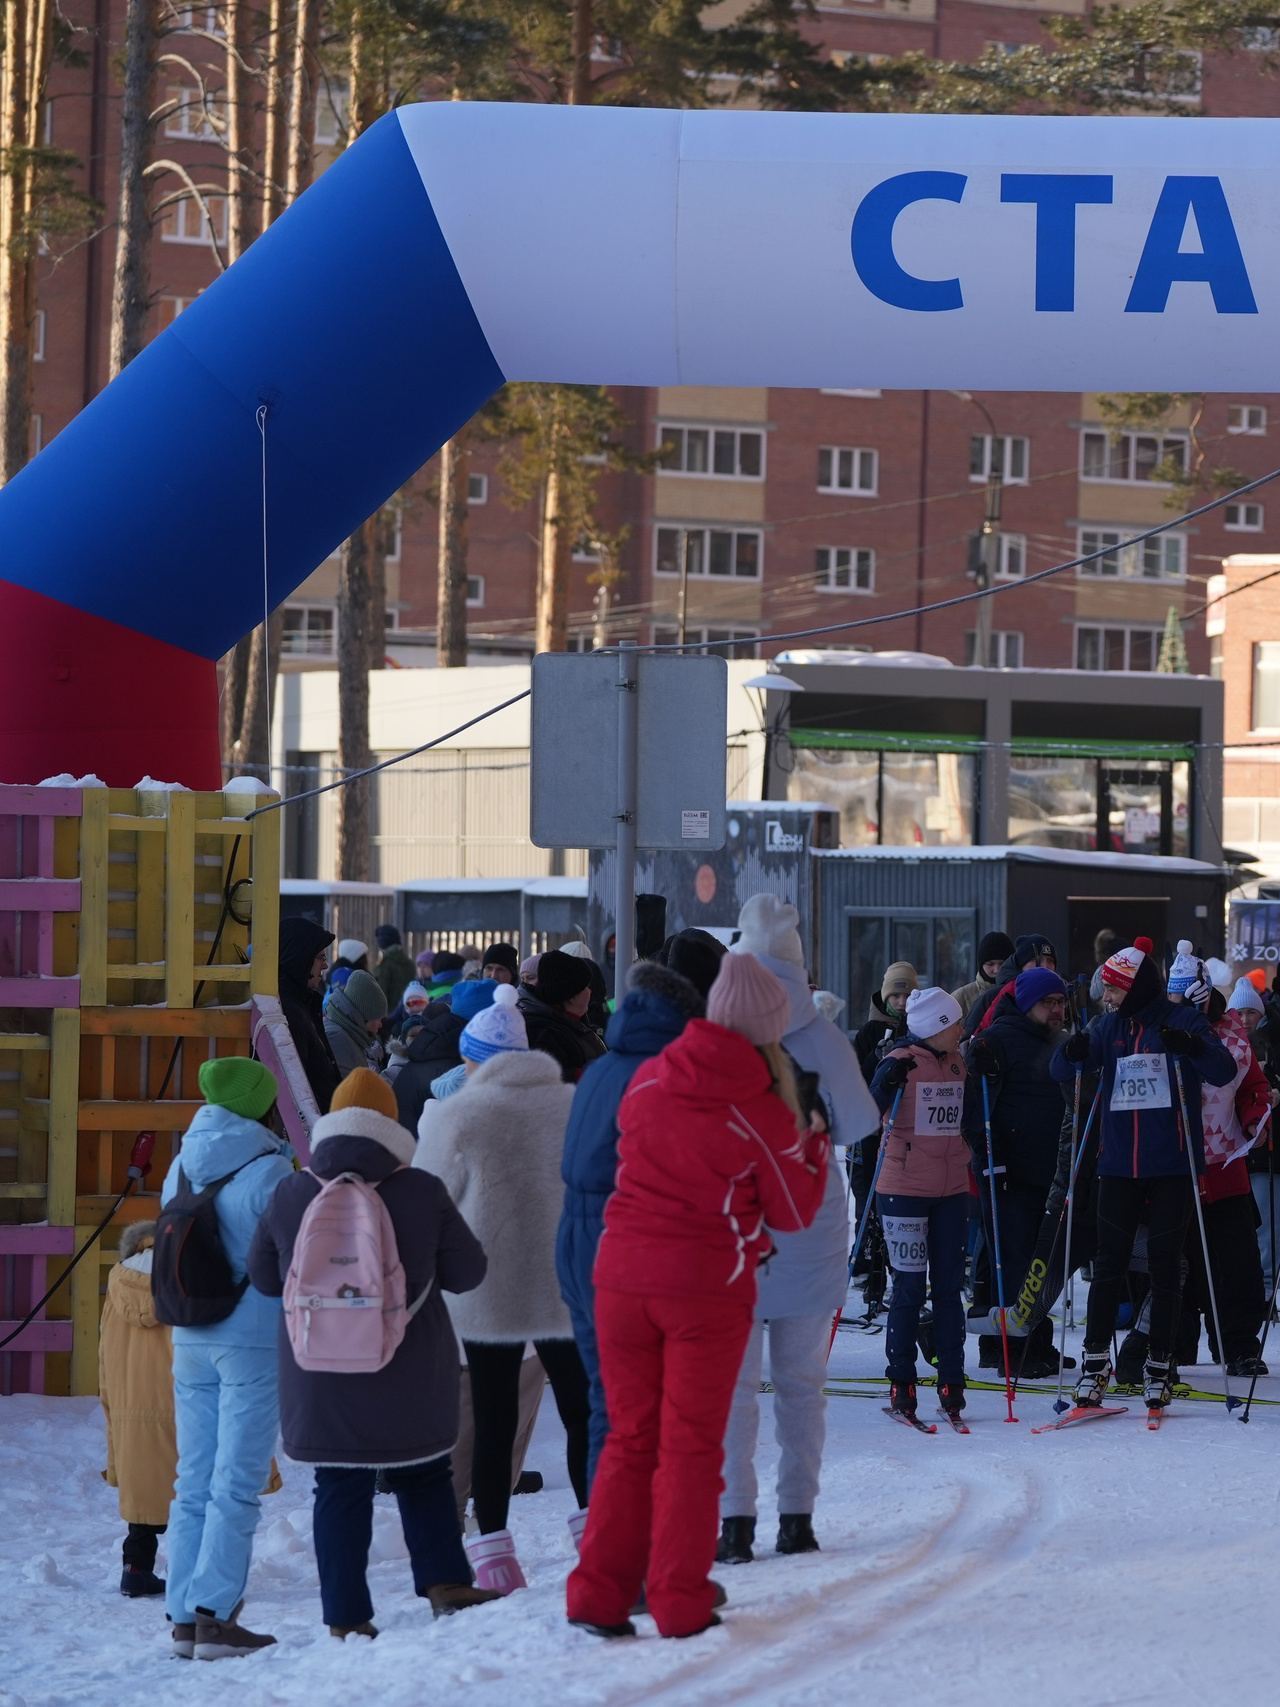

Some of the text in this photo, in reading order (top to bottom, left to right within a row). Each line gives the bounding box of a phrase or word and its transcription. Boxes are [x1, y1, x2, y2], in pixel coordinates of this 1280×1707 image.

[928, 1106, 959, 1124] 7069
[891, 1240, 926, 1259] 7069
[1012, 1258, 1047, 1329] CRAFT
[1113, 1387, 1190, 1398] FISER
